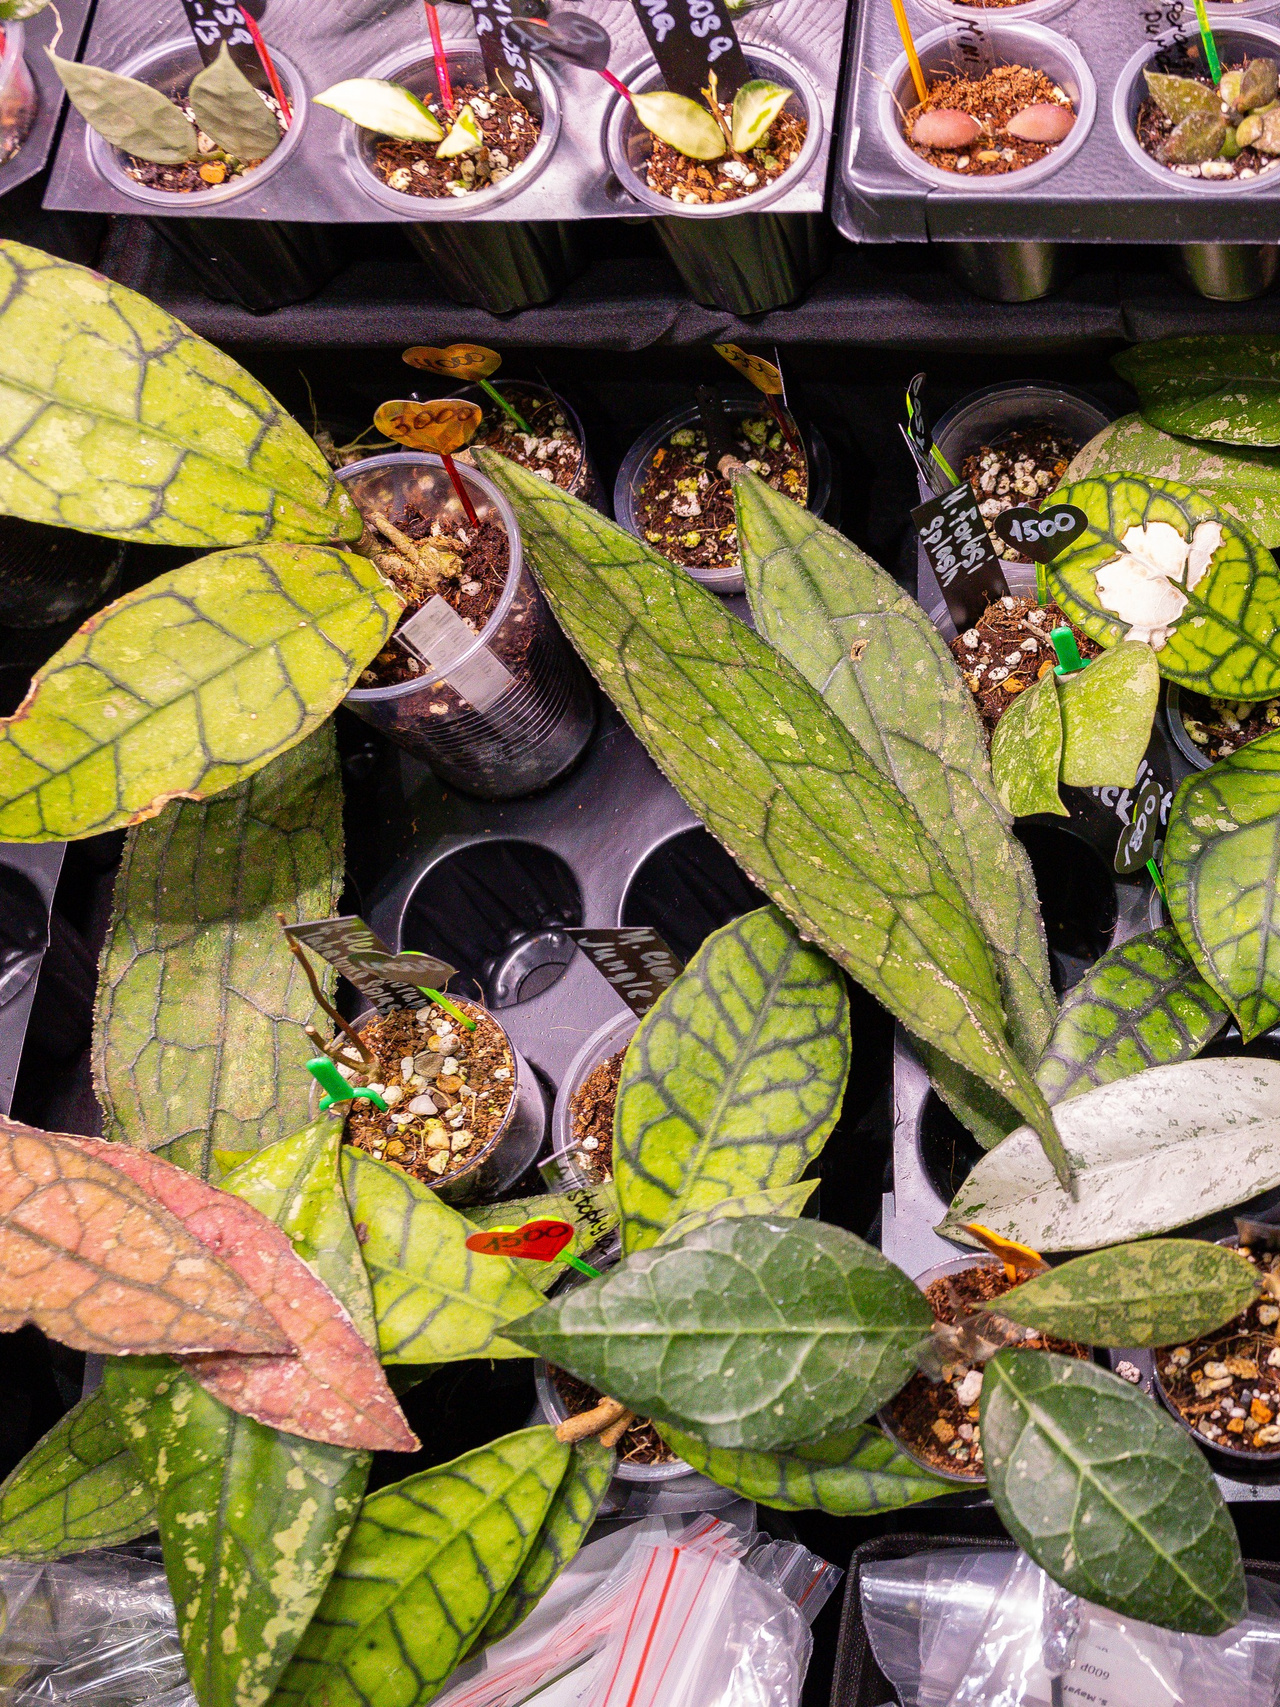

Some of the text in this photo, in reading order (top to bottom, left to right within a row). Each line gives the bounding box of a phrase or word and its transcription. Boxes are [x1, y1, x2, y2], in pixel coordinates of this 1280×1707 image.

[389, 406, 474, 438] 3000
[1009, 512, 1076, 543] 1500
[483, 1225, 570, 1251] 1500
[1080, 1663, 1111, 1680] 600P
